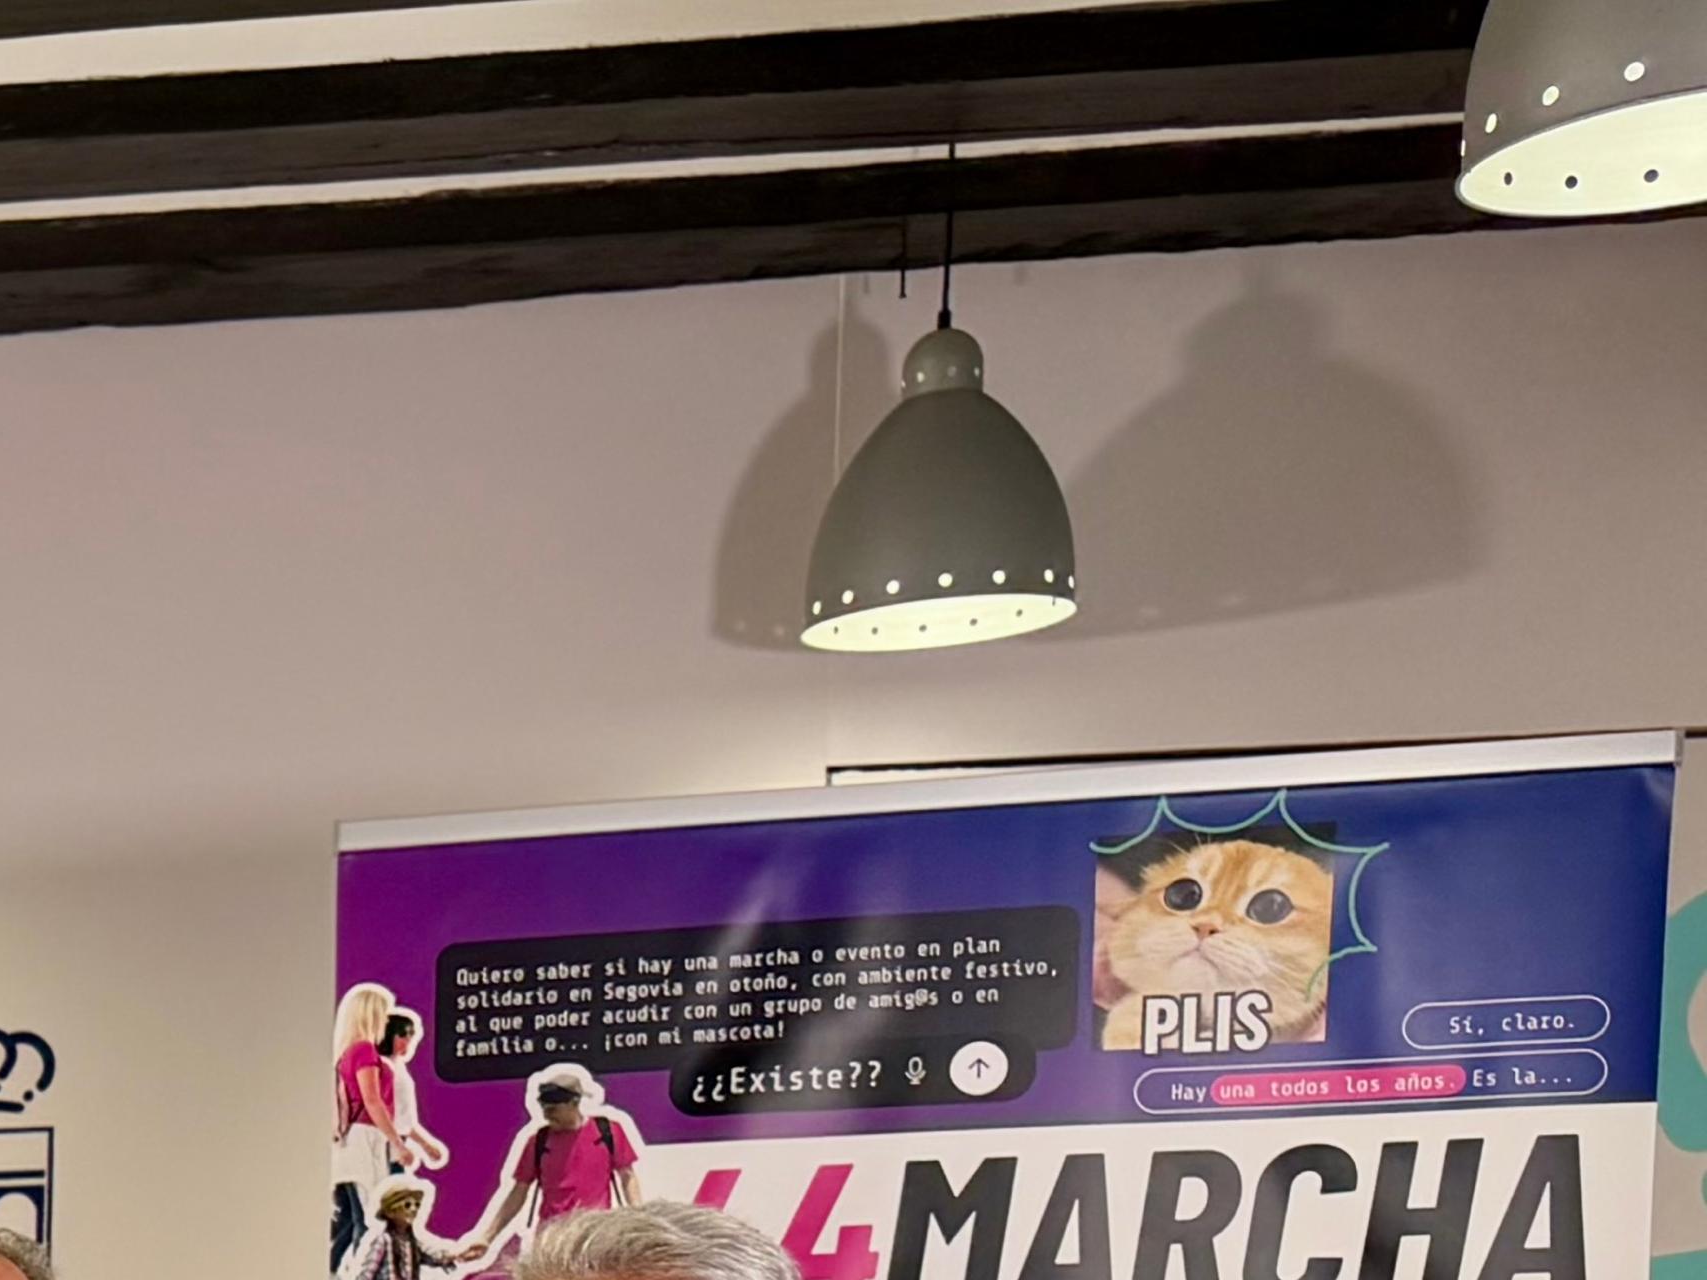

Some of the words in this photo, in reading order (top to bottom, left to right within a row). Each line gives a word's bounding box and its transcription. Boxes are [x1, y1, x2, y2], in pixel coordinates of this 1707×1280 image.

[455, 968, 524, 989] Quiero
[535, 963, 591, 983] saber
[604, 960, 628, 977] si
[638, 956, 672, 977] hay
[684, 954, 717, 971] una
[729, 947, 799, 969] marcha
[812, 949, 823, 964] o
[835, 943, 906, 962] evento
[916, 941, 941, 958] en
[953, 937, 1000, 959] plan
[455, 986, 558, 1009] solidario
[569, 986, 592, 1002] en
[603, 980, 683, 1004] Segovia
[695, 977, 718, 995] en
[729, 973, 797, 993] otoño,
[812, 971, 846, 987] con
[858, 963, 951, 985] ambiente
[965, 958, 1058, 980] festivo,
[455, 1016, 478, 1033] al
[489, 1013, 523, 1033] que
[534, 1007, 590, 1030] poder
[603, 1002, 672, 1024] acudir
[683, 1003, 717, 1020] con
[729, 1001, 752, 1017] un
[764, 994, 821, 1018] grupo
[834, 990, 856, 1009] de
[868, 988, 939, 1010] amig@s
[952, 988, 963, 1003] o
[975, 987, 998, 1003] en
[1142, 989, 1271, 1054] PLIS
[1449, 1018, 1484, 1034] Sí,
[1501, 1011, 1574, 1032] claro.
[455, 1035, 533, 1058] familia
[544, 1035, 589, 1052] o...
[603, 1029, 649, 1051] ¡con
[658, 1026, 682, 1045] mi
[693, 1021, 785, 1043] mascota!
[691, 1060, 882, 1102] ¿¿Existe??
[1170, 1082, 1207, 1103] Hay
[1219, 1082, 1255, 1098] una
[1270, 1077, 1329, 1096] todos
[1345, 1073, 1379, 1094] los
[1394, 1070, 1455, 1092] años.
[1472, 1069, 1496, 1088] Es
[1513, 1066, 1573, 1086] la...
